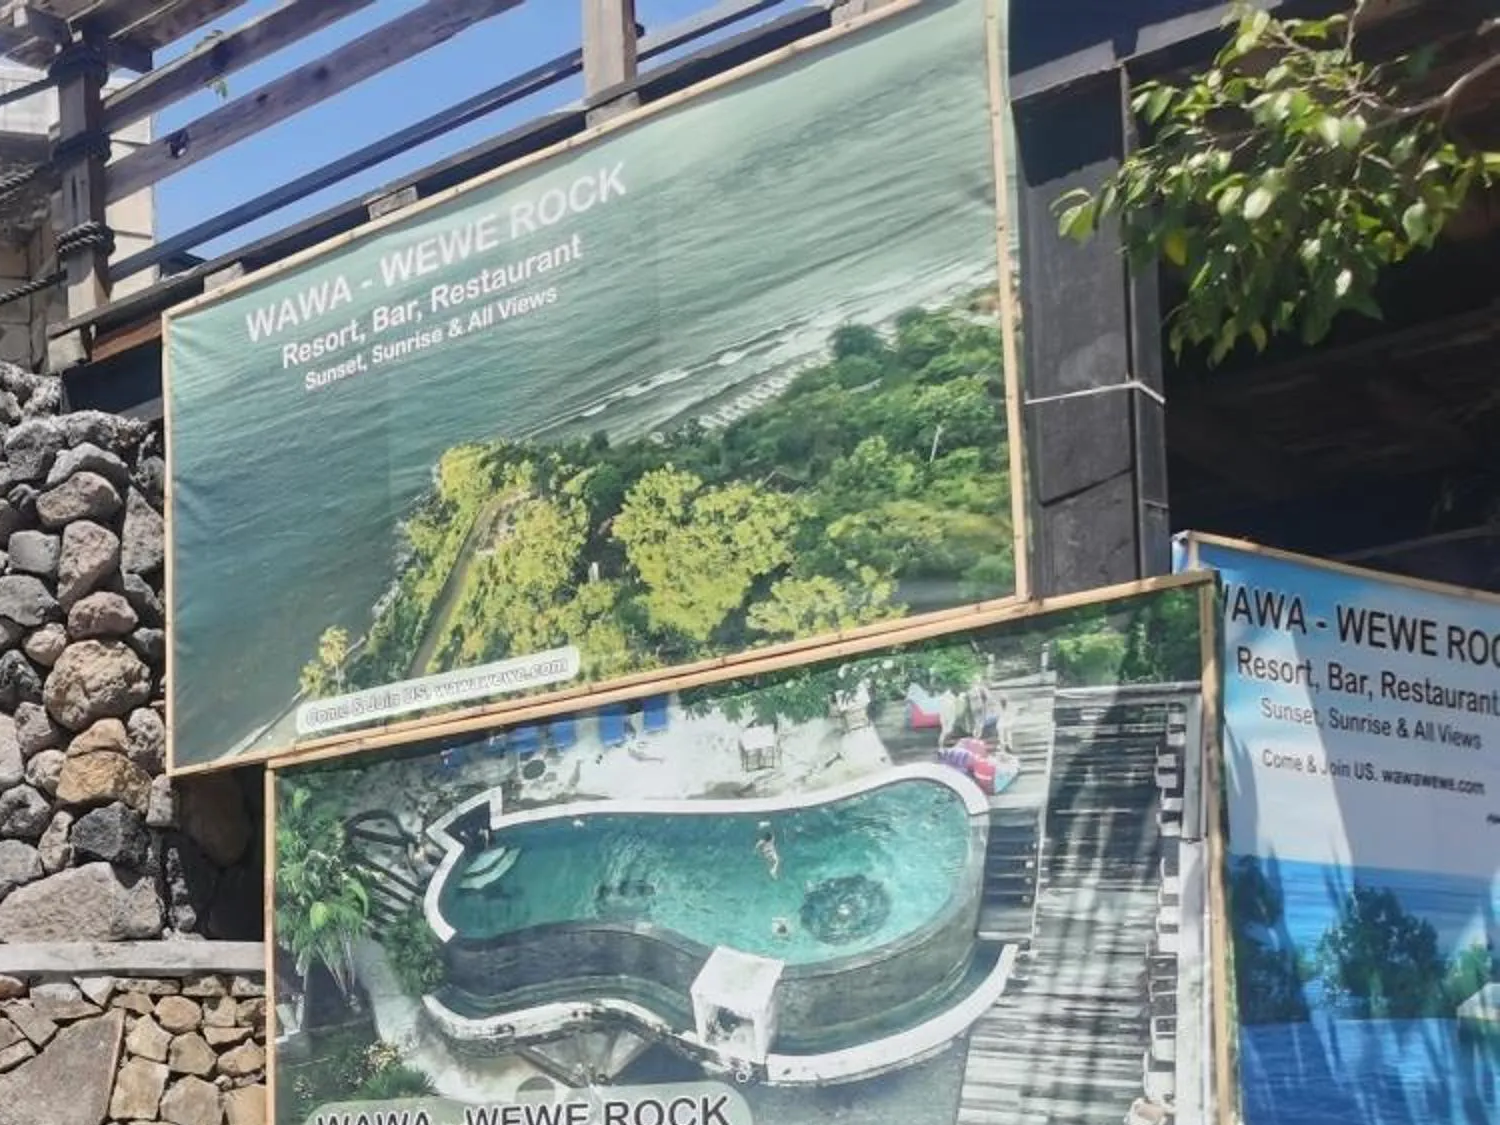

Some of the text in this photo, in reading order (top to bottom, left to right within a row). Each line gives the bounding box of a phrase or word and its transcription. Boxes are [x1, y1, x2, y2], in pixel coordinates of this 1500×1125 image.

[244, 274, 352, 343] WAWA
[380, 213, 499, 288] WEWE
[509, 160, 627, 235] ROCK
[282, 232, 583, 370] Resort, Bar, Restaurant
[304, 284, 557, 390] Sunset, Sunrise & All Views
[1222, 583, 1307, 634] AWA
[1336, 604, 1438, 657] WEWE
[1236, 646, 1500, 717] Resort, Bar, Restaurant
[1260, 697, 1483, 750] Sunset, Sunrise & All Views
[1261, 748, 1304, 773] Come
[1307, 755, 1319, 775] &
[1353, 761, 1378, 782] US.
[1381, 767, 1486, 796] wawawewe.com
